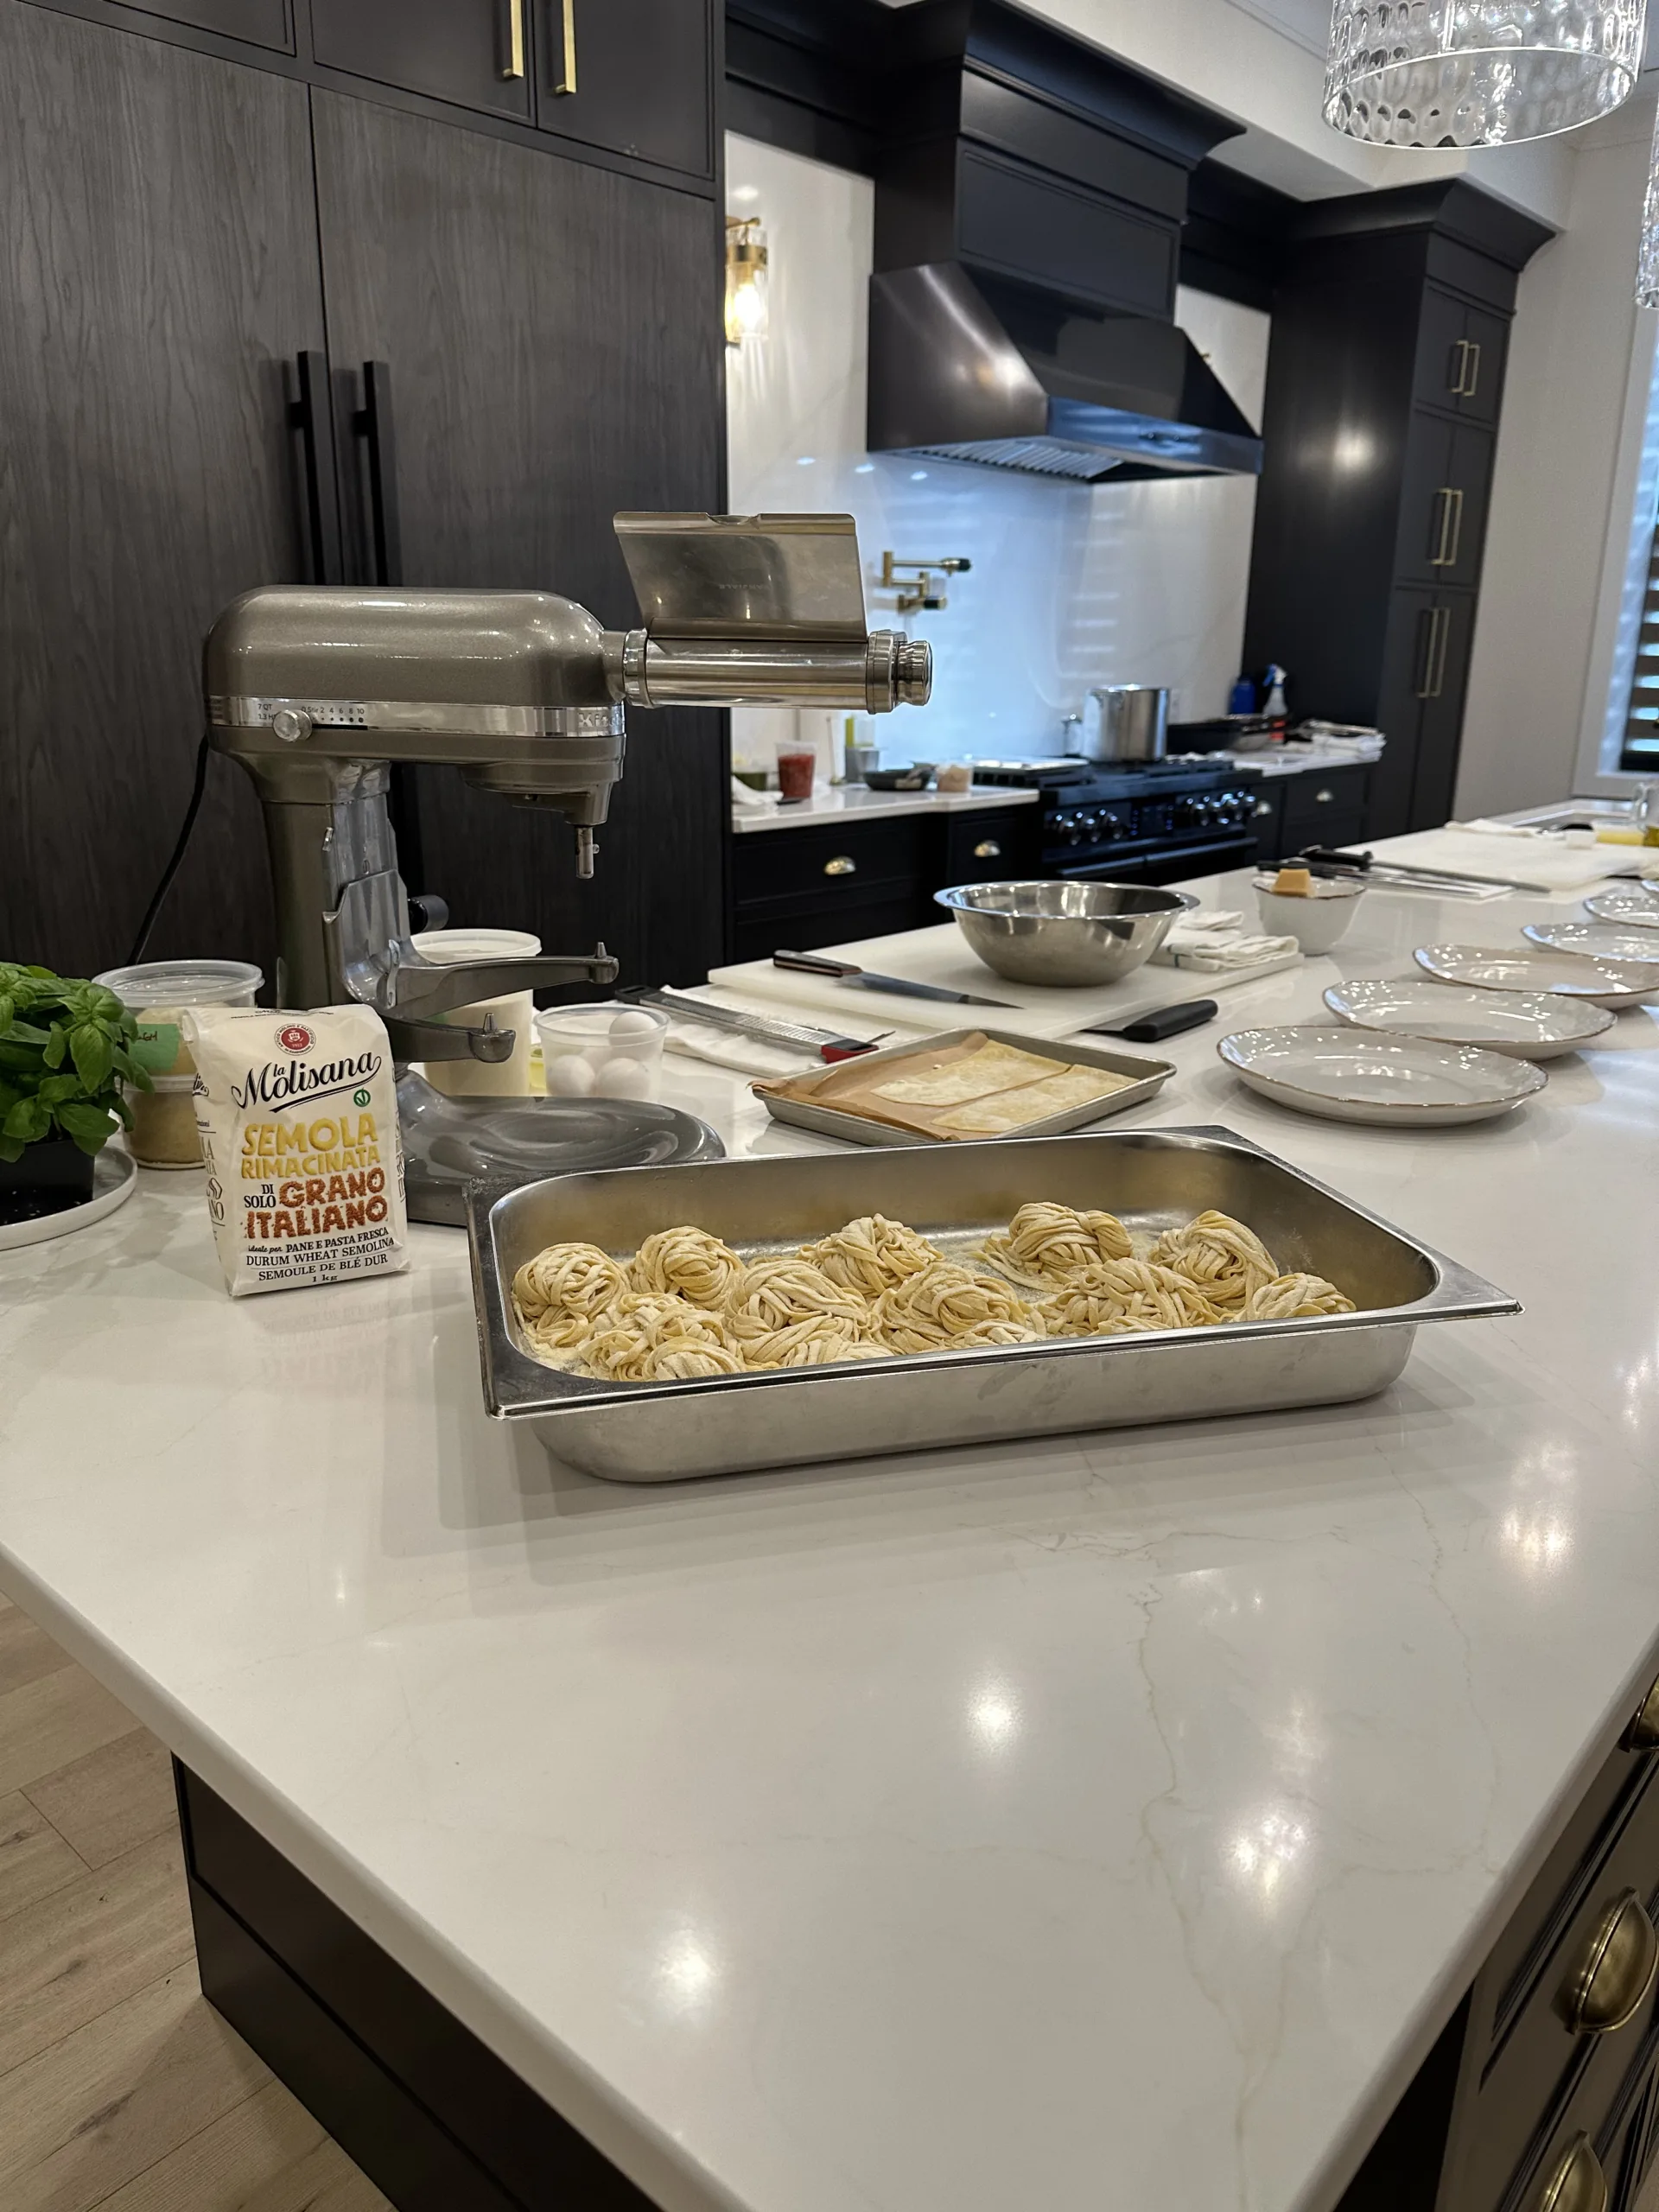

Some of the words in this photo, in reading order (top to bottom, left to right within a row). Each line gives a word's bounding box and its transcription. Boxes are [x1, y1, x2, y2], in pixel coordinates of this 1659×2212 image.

[231, 1052, 382, 1109] Molisana
[273, 1063, 287, 1077] la
[241, 1113, 378, 1156] SEMOLA
[241, 1145, 381, 1179] RIMACINATA
[244, 1195, 276, 1209] SOLO
[261, 1183, 276, 1195] DI
[278, 1166, 385, 1208] GRANO
[246, 1195, 388, 1239] ITALIANO
[245, 1255, 290, 1267] DURUM
[293, 1249, 339, 1263] WHEAT
[341, 1236, 395, 1257] SEMOLINA
[269, 1246, 283, 1255] per
[286, 1241, 315, 1253] PANE
[315, 1239, 323, 1250] E
[324, 1235, 356, 1249] PASTA
[357, 1226, 390, 1243] FRESCA
[258, 1265, 316, 1281] SEMOULE
[320, 1262, 336, 1272] DE
[340, 1256, 361, 1270] BLÉ
[365, 1253, 389, 1267] DUR
